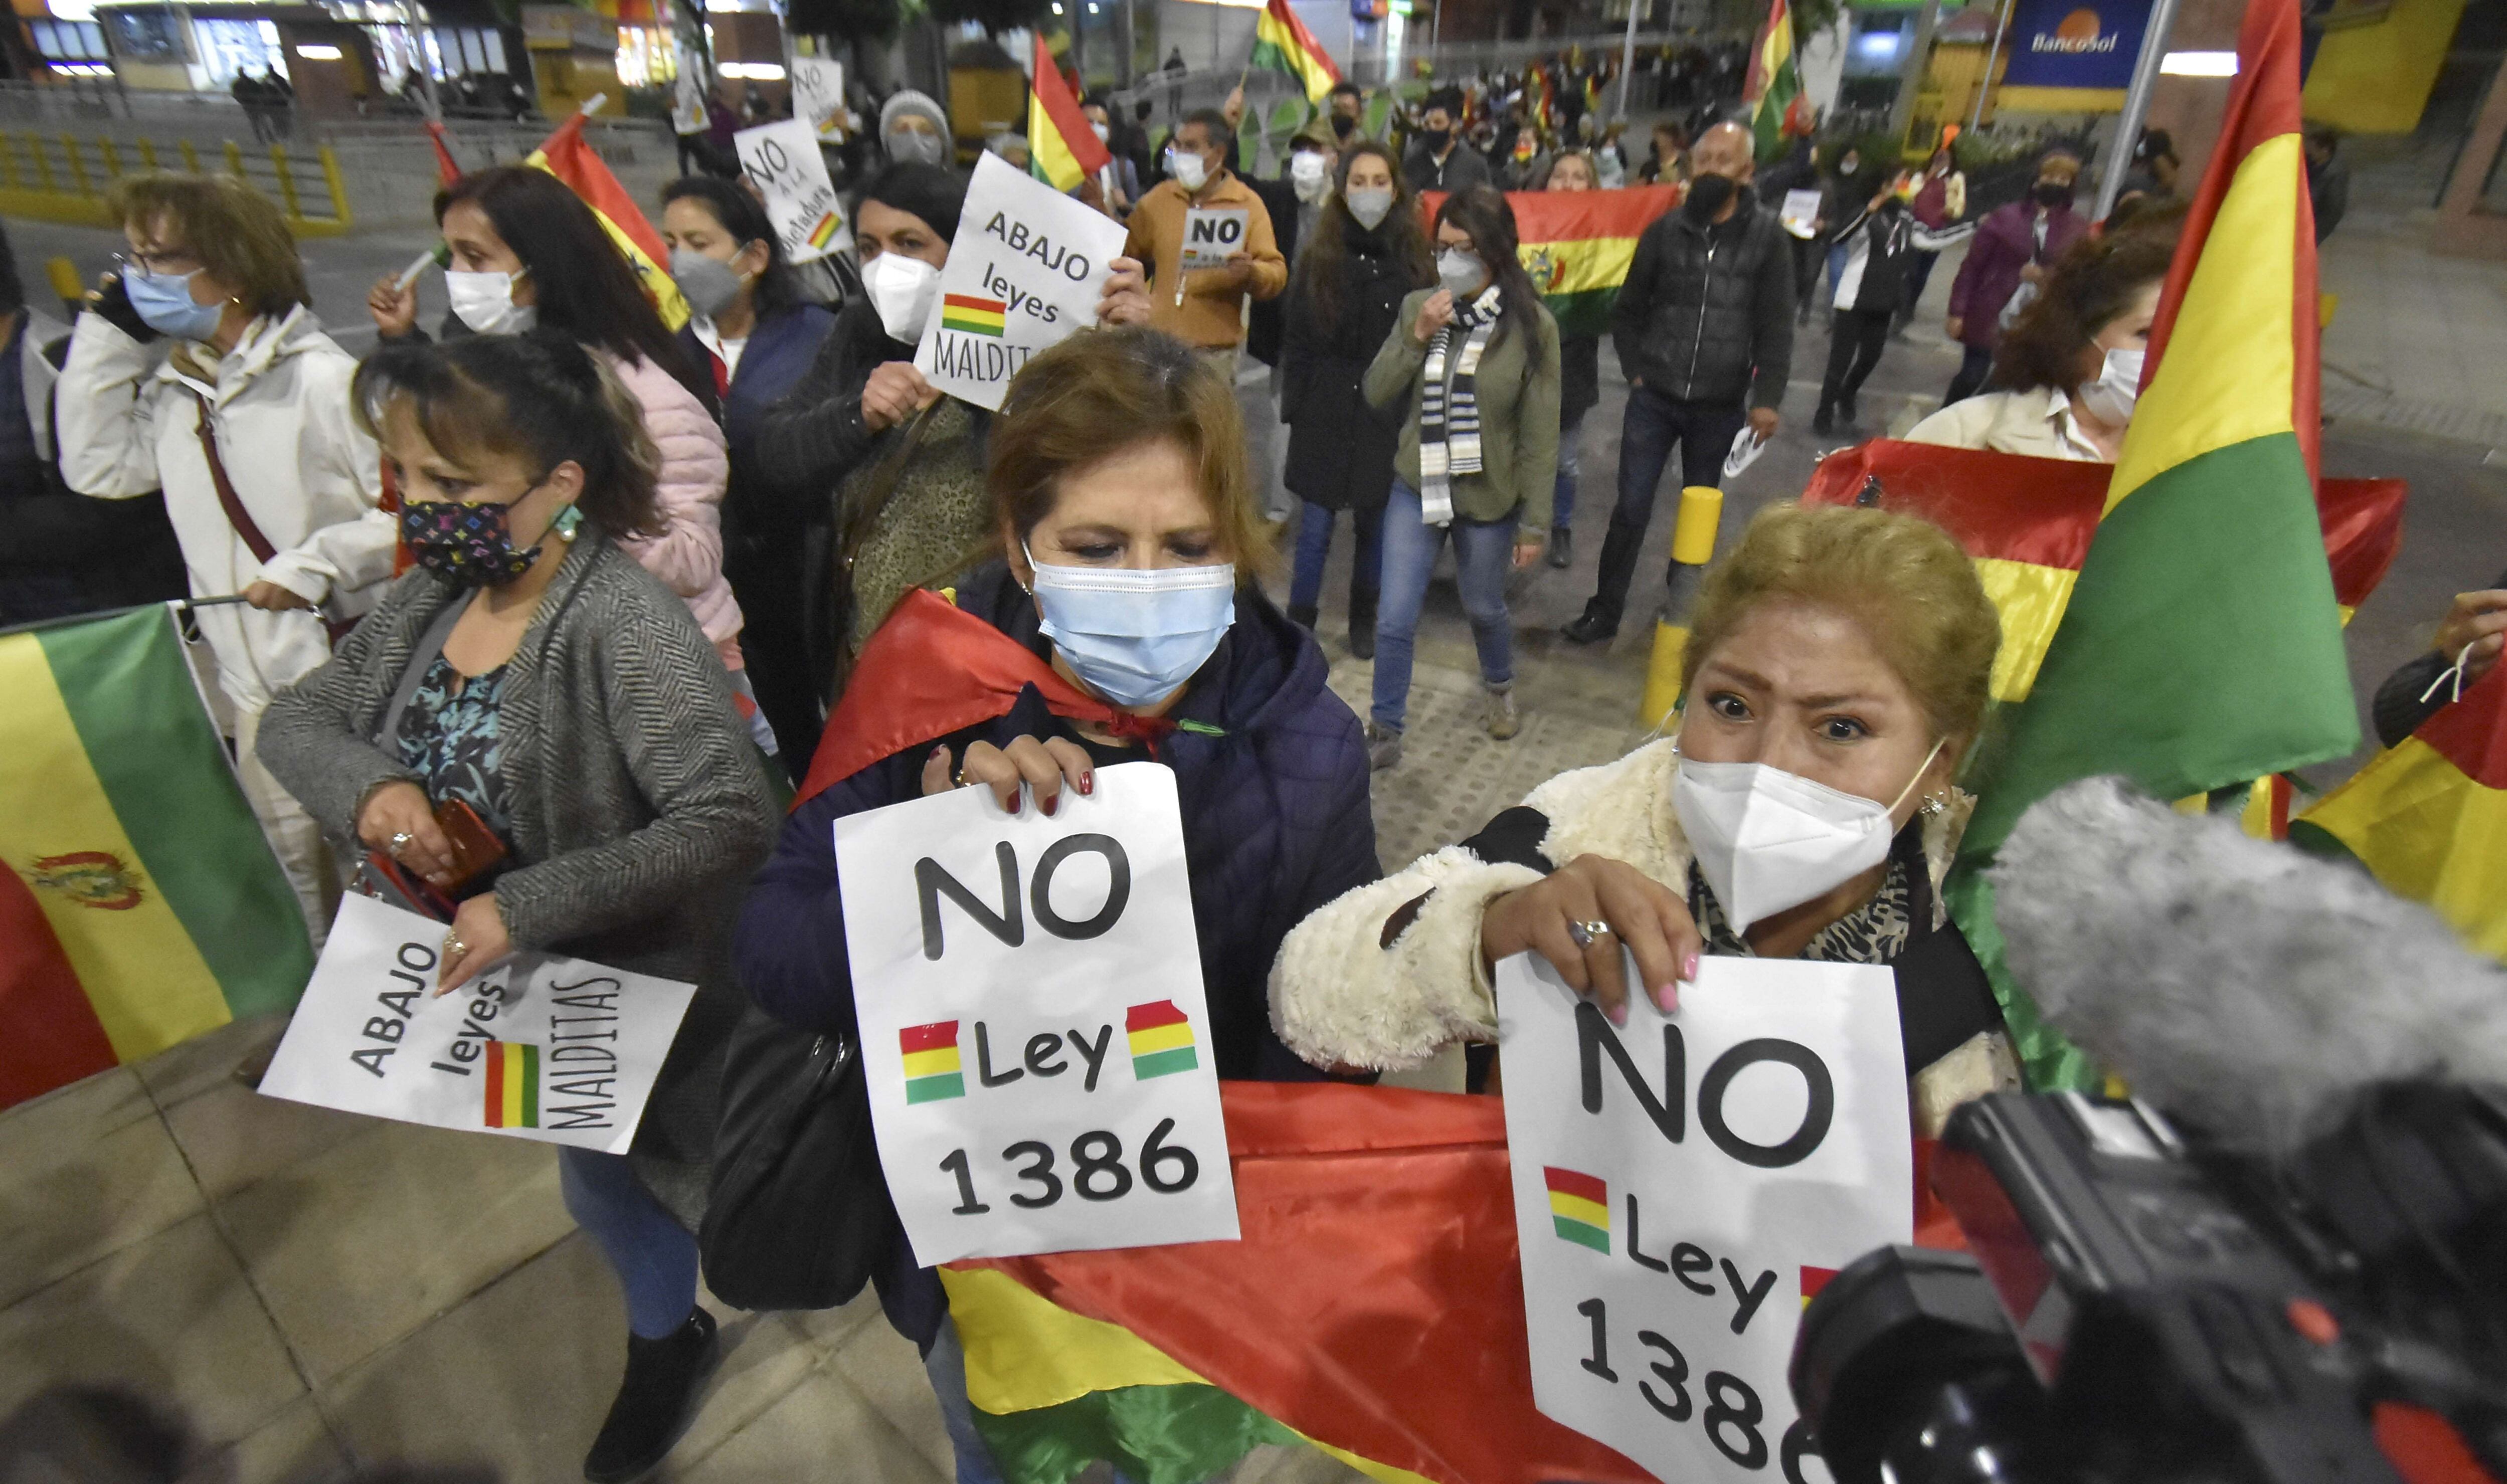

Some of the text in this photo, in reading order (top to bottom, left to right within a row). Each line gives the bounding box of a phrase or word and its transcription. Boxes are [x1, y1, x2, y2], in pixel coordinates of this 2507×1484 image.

[2031, 32, 2118, 52] BancoSol
[744, 137, 788, 190] NO
[985, 211, 1090, 281] ABAJO
[1191, 217, 1240, 244] NO
[982, 262, 1059, 323] leyes
[914, 832, 1131, 962] NO
[349, 942, 437, 1078] ABAJO
[430, 981, 505, 1076] leyes
[547, 976, 622, 1130] MALDITAS
[974, 1020, 1113, 1092] Ley
[1574, 1001, 1834, 1169] NO
[939, 1118, 1199, 1215] 1386
[1627, 1193, 1777, 1335] Ley
